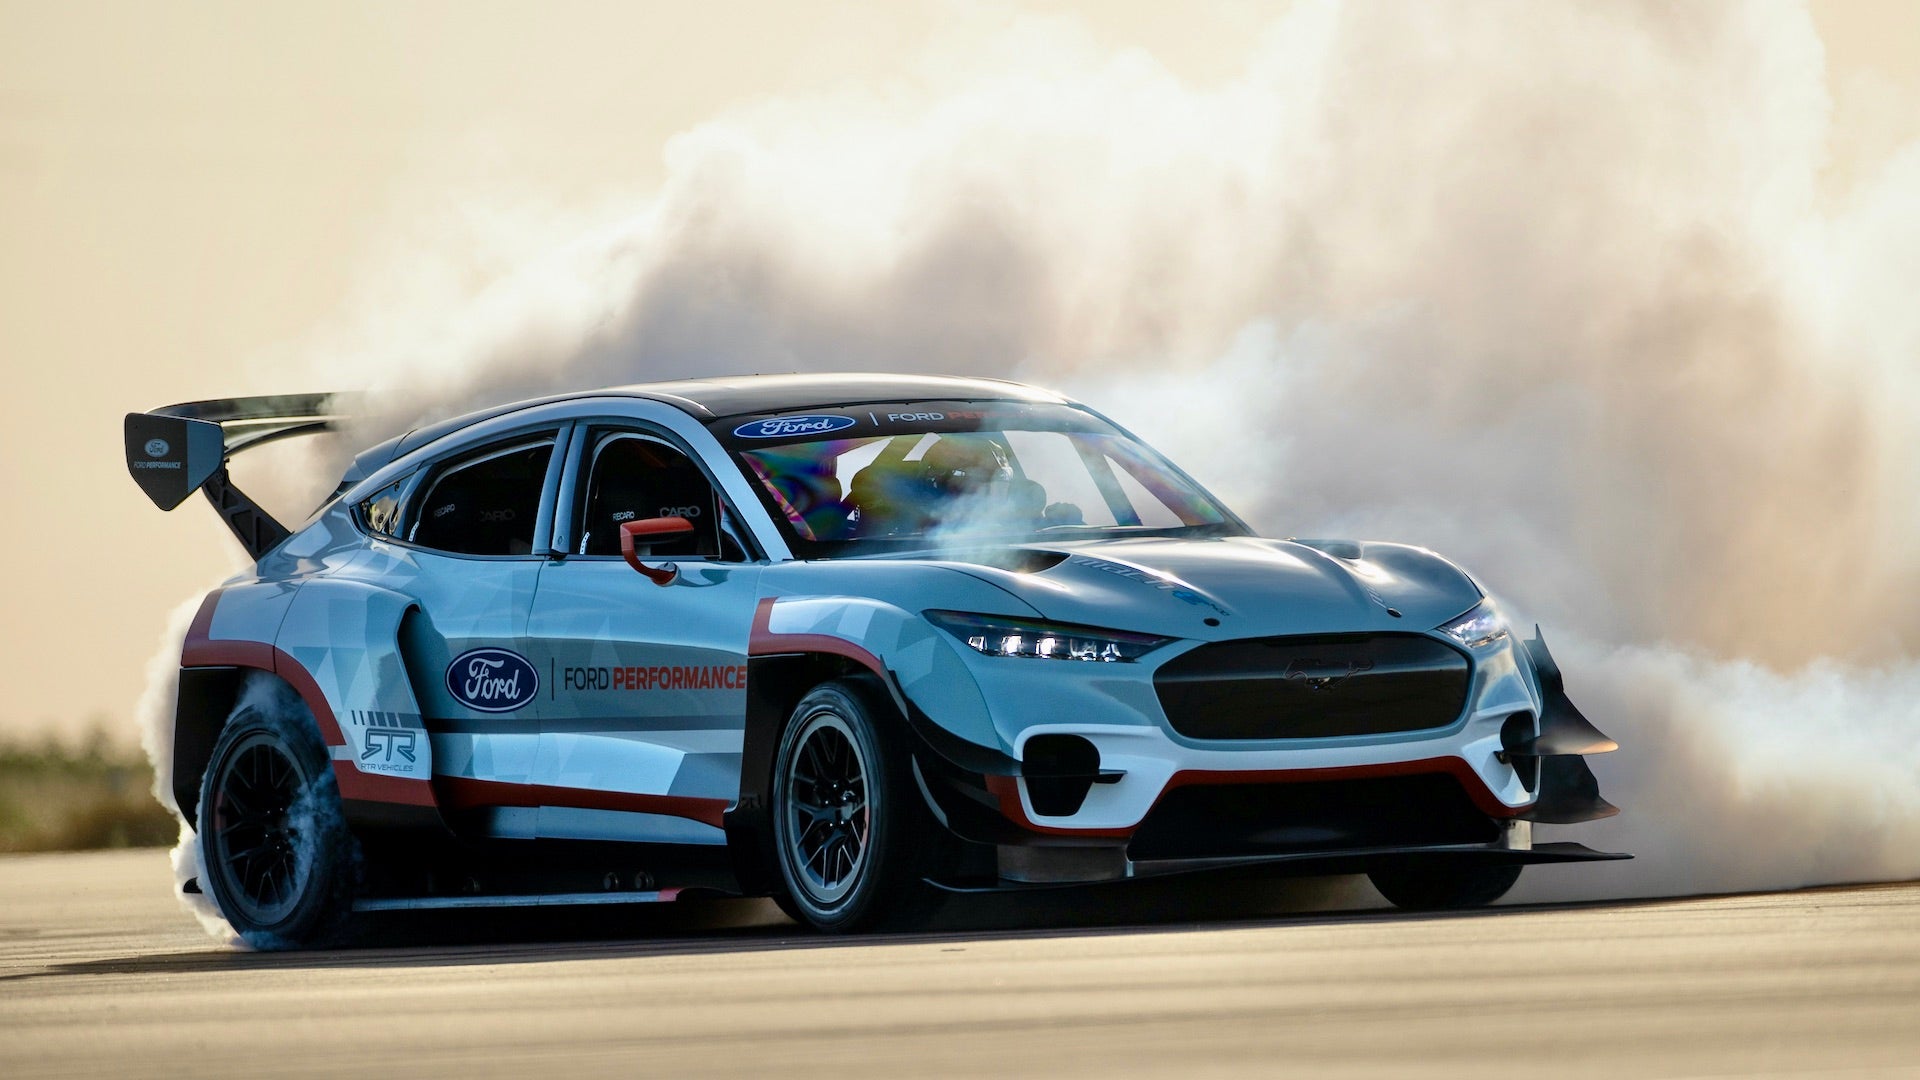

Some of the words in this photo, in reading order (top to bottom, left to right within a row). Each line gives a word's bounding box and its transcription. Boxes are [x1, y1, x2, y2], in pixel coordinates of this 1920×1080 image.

[887, 412, 945, 422] FORD
[760, 418, 833, 435] Ford
[612, 510, 635, 521] RECARO
[660, 505, 701, 518] CARO
[465, 658, 521, 700] Ford
[565, 667, 609, 690] FORD
[613, 665, 747, 691] PERFORMANCE
[378, 764, 414, 772] VEHICLES
